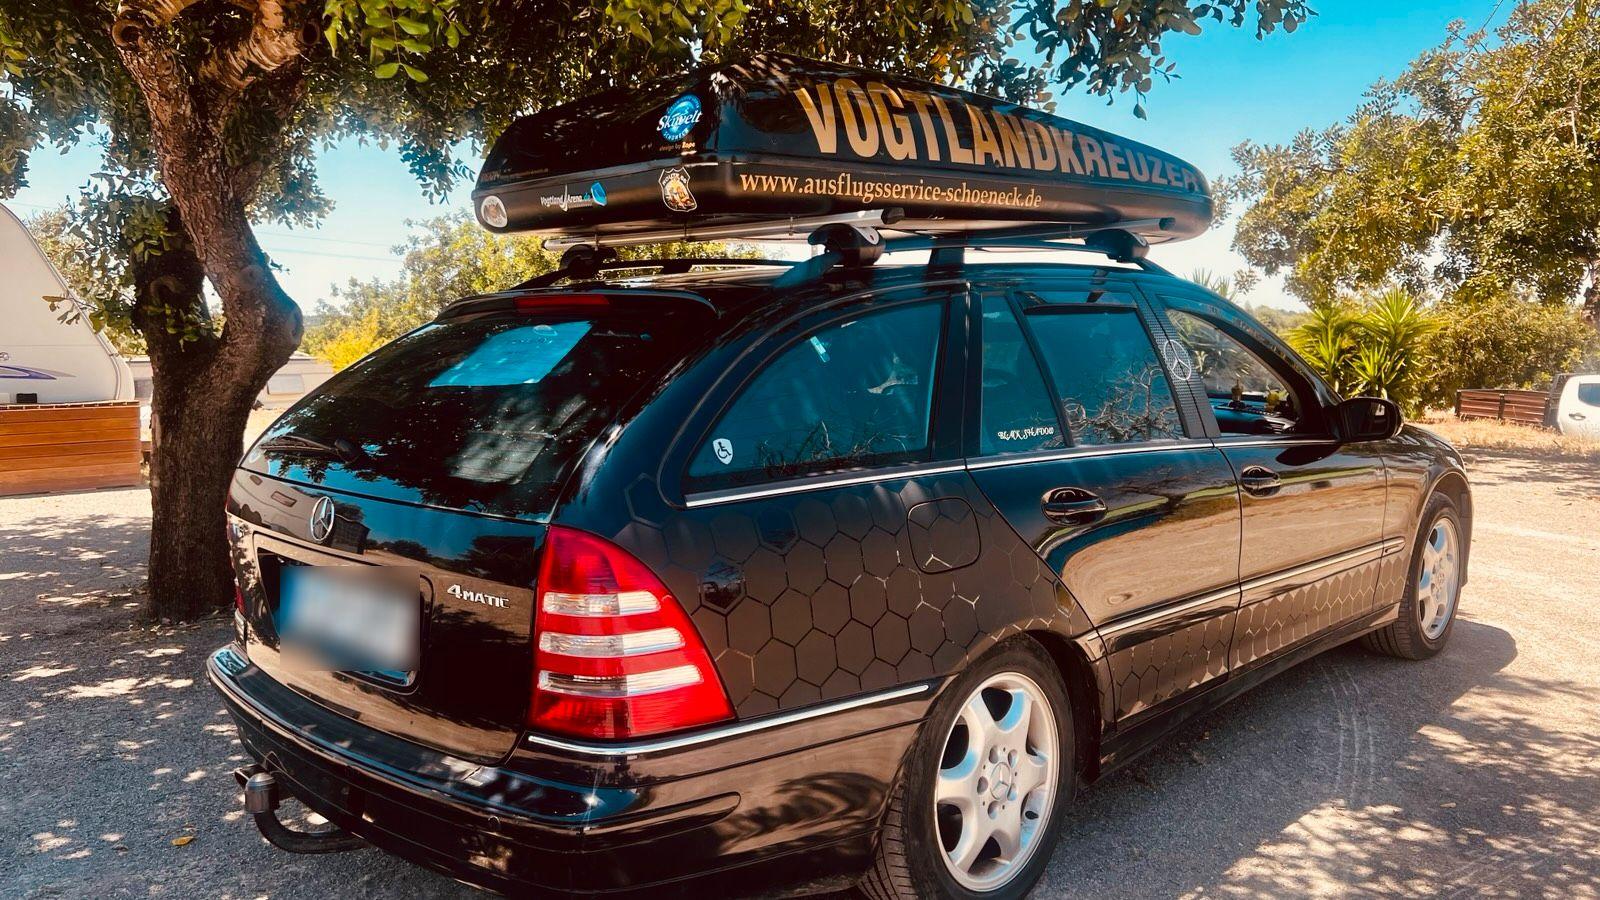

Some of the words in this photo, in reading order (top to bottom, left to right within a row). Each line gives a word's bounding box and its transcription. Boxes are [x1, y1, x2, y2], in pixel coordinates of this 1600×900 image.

[656, 109, 703, 131] Skiwelt
[795, 79, 1200, 192] VOGTLANDKREUZER
[740, 171, 1042, 209] www.ausflugsservice-schoeneck.de
[447, 584, 510, 609] 4MATIC
